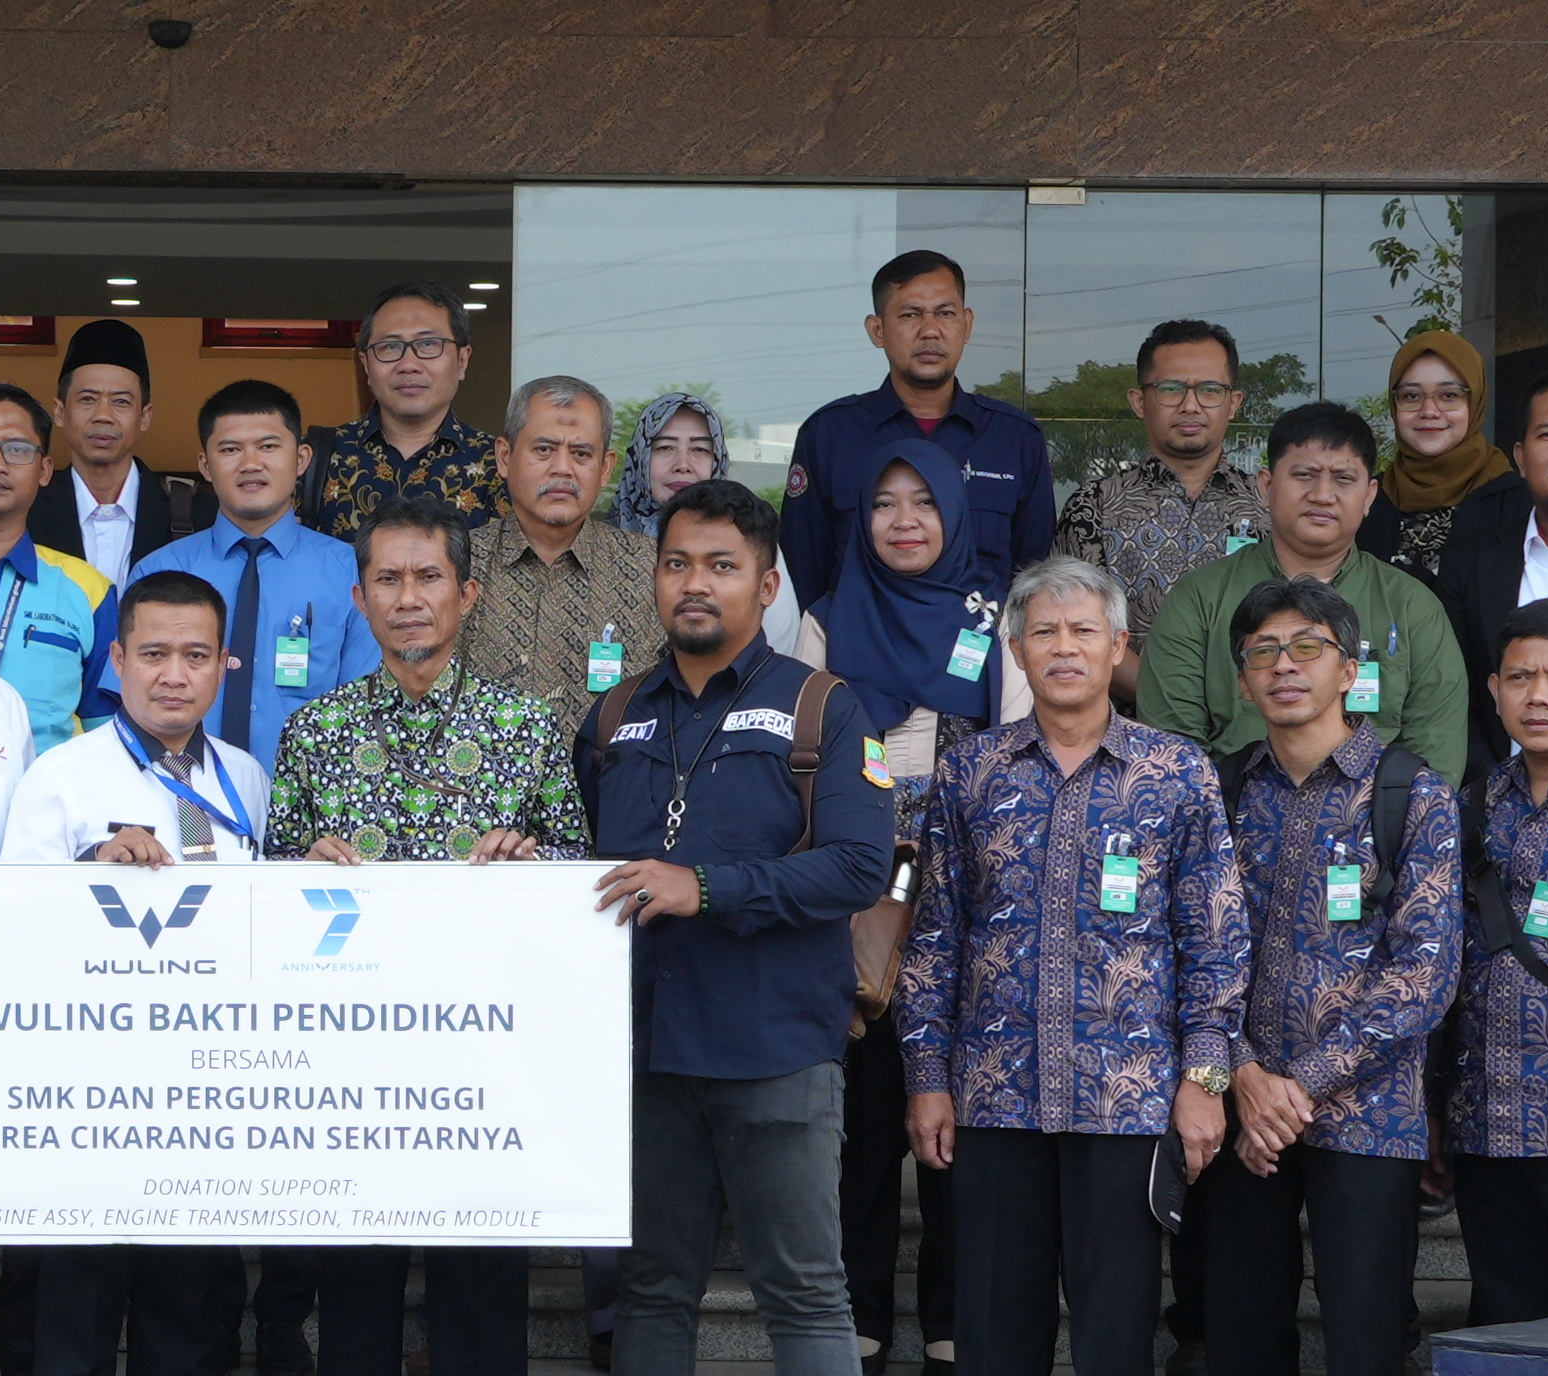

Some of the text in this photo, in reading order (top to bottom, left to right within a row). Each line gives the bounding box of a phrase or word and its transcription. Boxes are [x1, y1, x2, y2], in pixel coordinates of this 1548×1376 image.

[727, 711, 793, 737] BAPPEDA
[84, 959, 217, 975] WULING
[281, 962, 381, 972] ANNIVERSARY
[148, 1002, 258, 1032] BAKTI
[273, 1002, 514, 1033] PENDIDIKAN
[191, 1049, 312, 1070] BERSAMA
[7, 1085, 485, 1112] SMK DAN PERGURUAN TINGGI
[70, 1125, 235, 1150] CIKARANG
[247, 1125, 315, 1150] DAN
[326, 1125, 524, 1151] SEKITARNYA
[143, 1178, 358, 1197] DONATION SUPPORT:
[42, 1208, 95, 1228] ASSY,
[104, 1208, 180, 1226] ENGINE
[187, 1209, 341, 1229] TRANSMISSION,
[351, 1209, 447, 1227] TRAINING
[453, 1209, 543, 1228] MODULE
